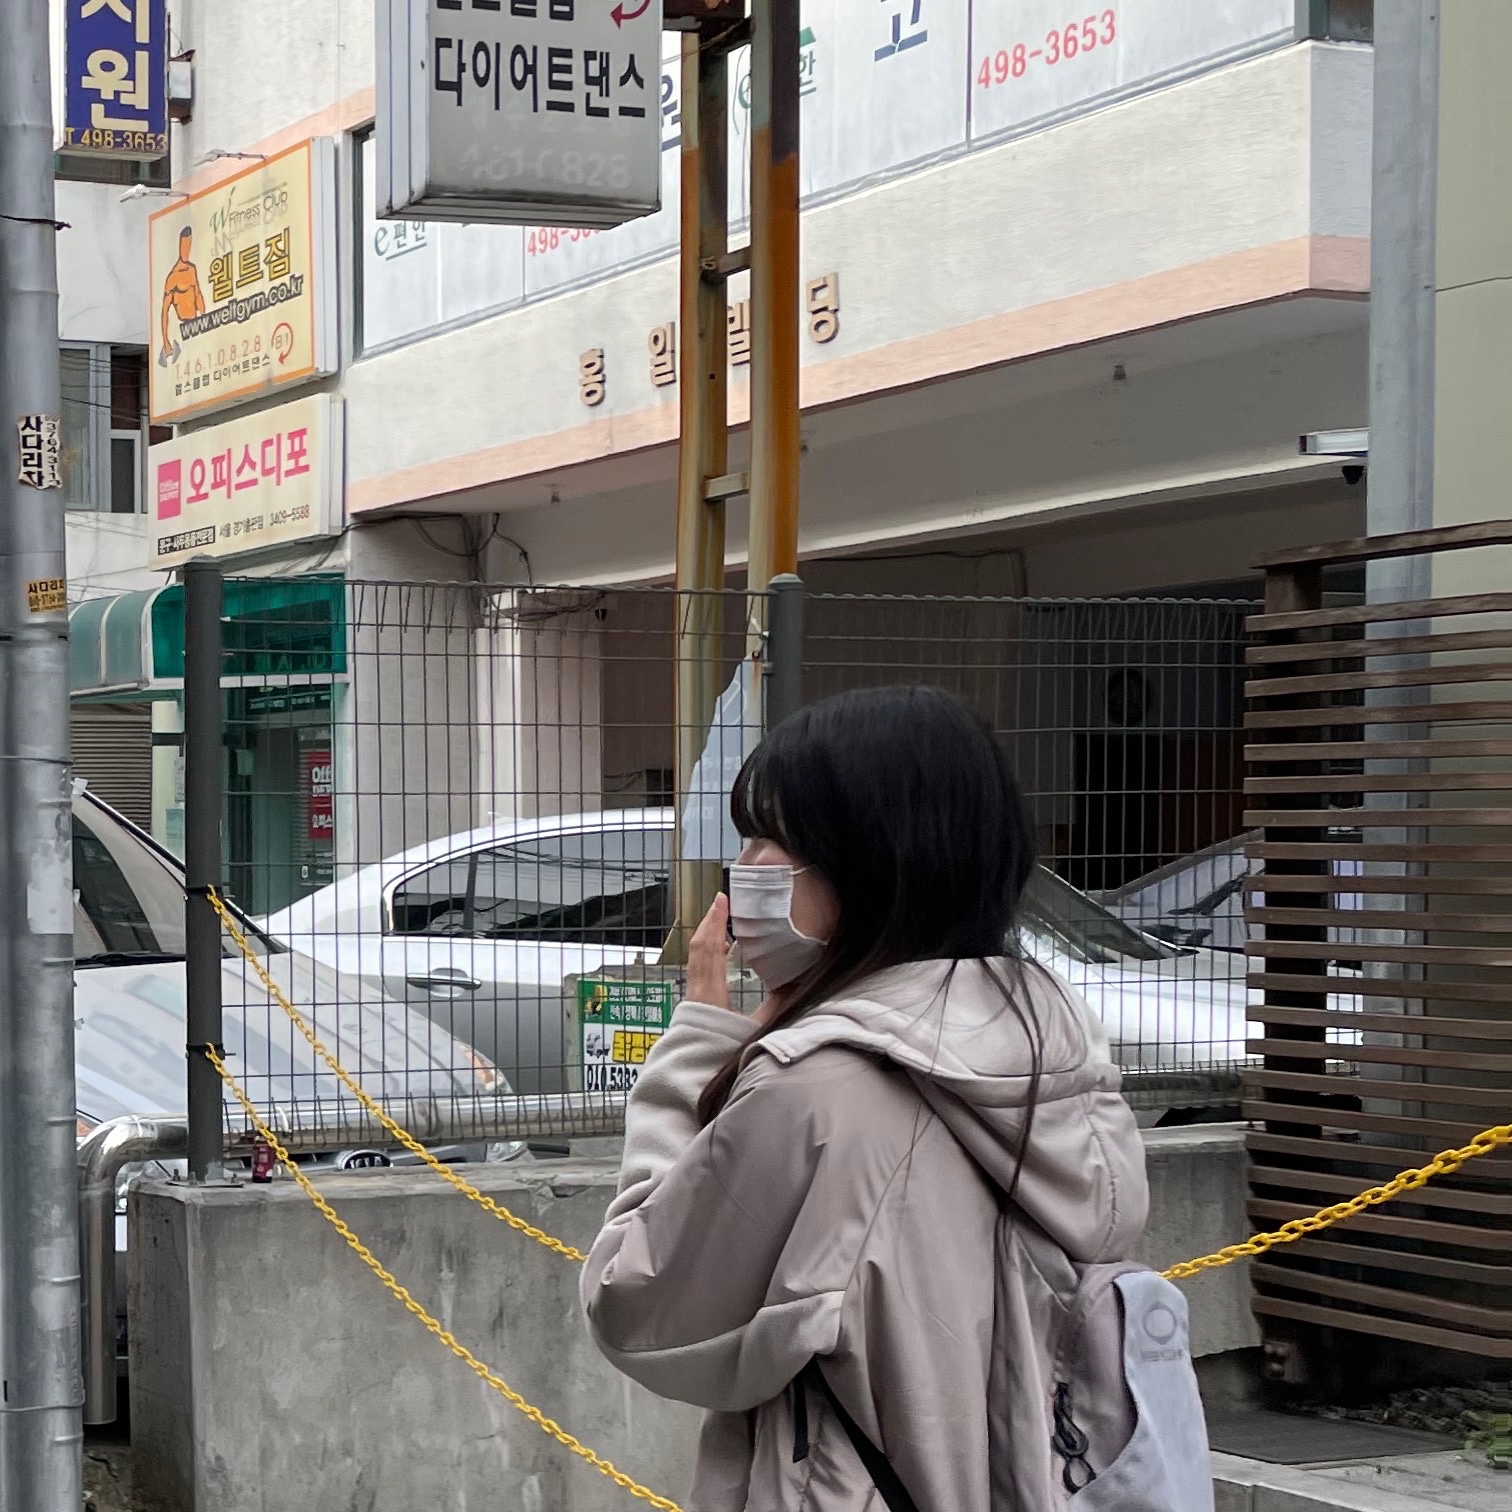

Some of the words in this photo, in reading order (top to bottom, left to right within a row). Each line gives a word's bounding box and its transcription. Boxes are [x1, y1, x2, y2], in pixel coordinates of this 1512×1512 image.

[435, 37, 646, 118] 다이어트댄스
[977, 9, 1117, 90] 498-3653
[81, 129, 169, 150] 498-3653
[208, 226, 291, 304] 웰트짐
[181, 275, 303, 340] www.weltgym.co.kr
[186, 427, 311, 504] 오피스디포
